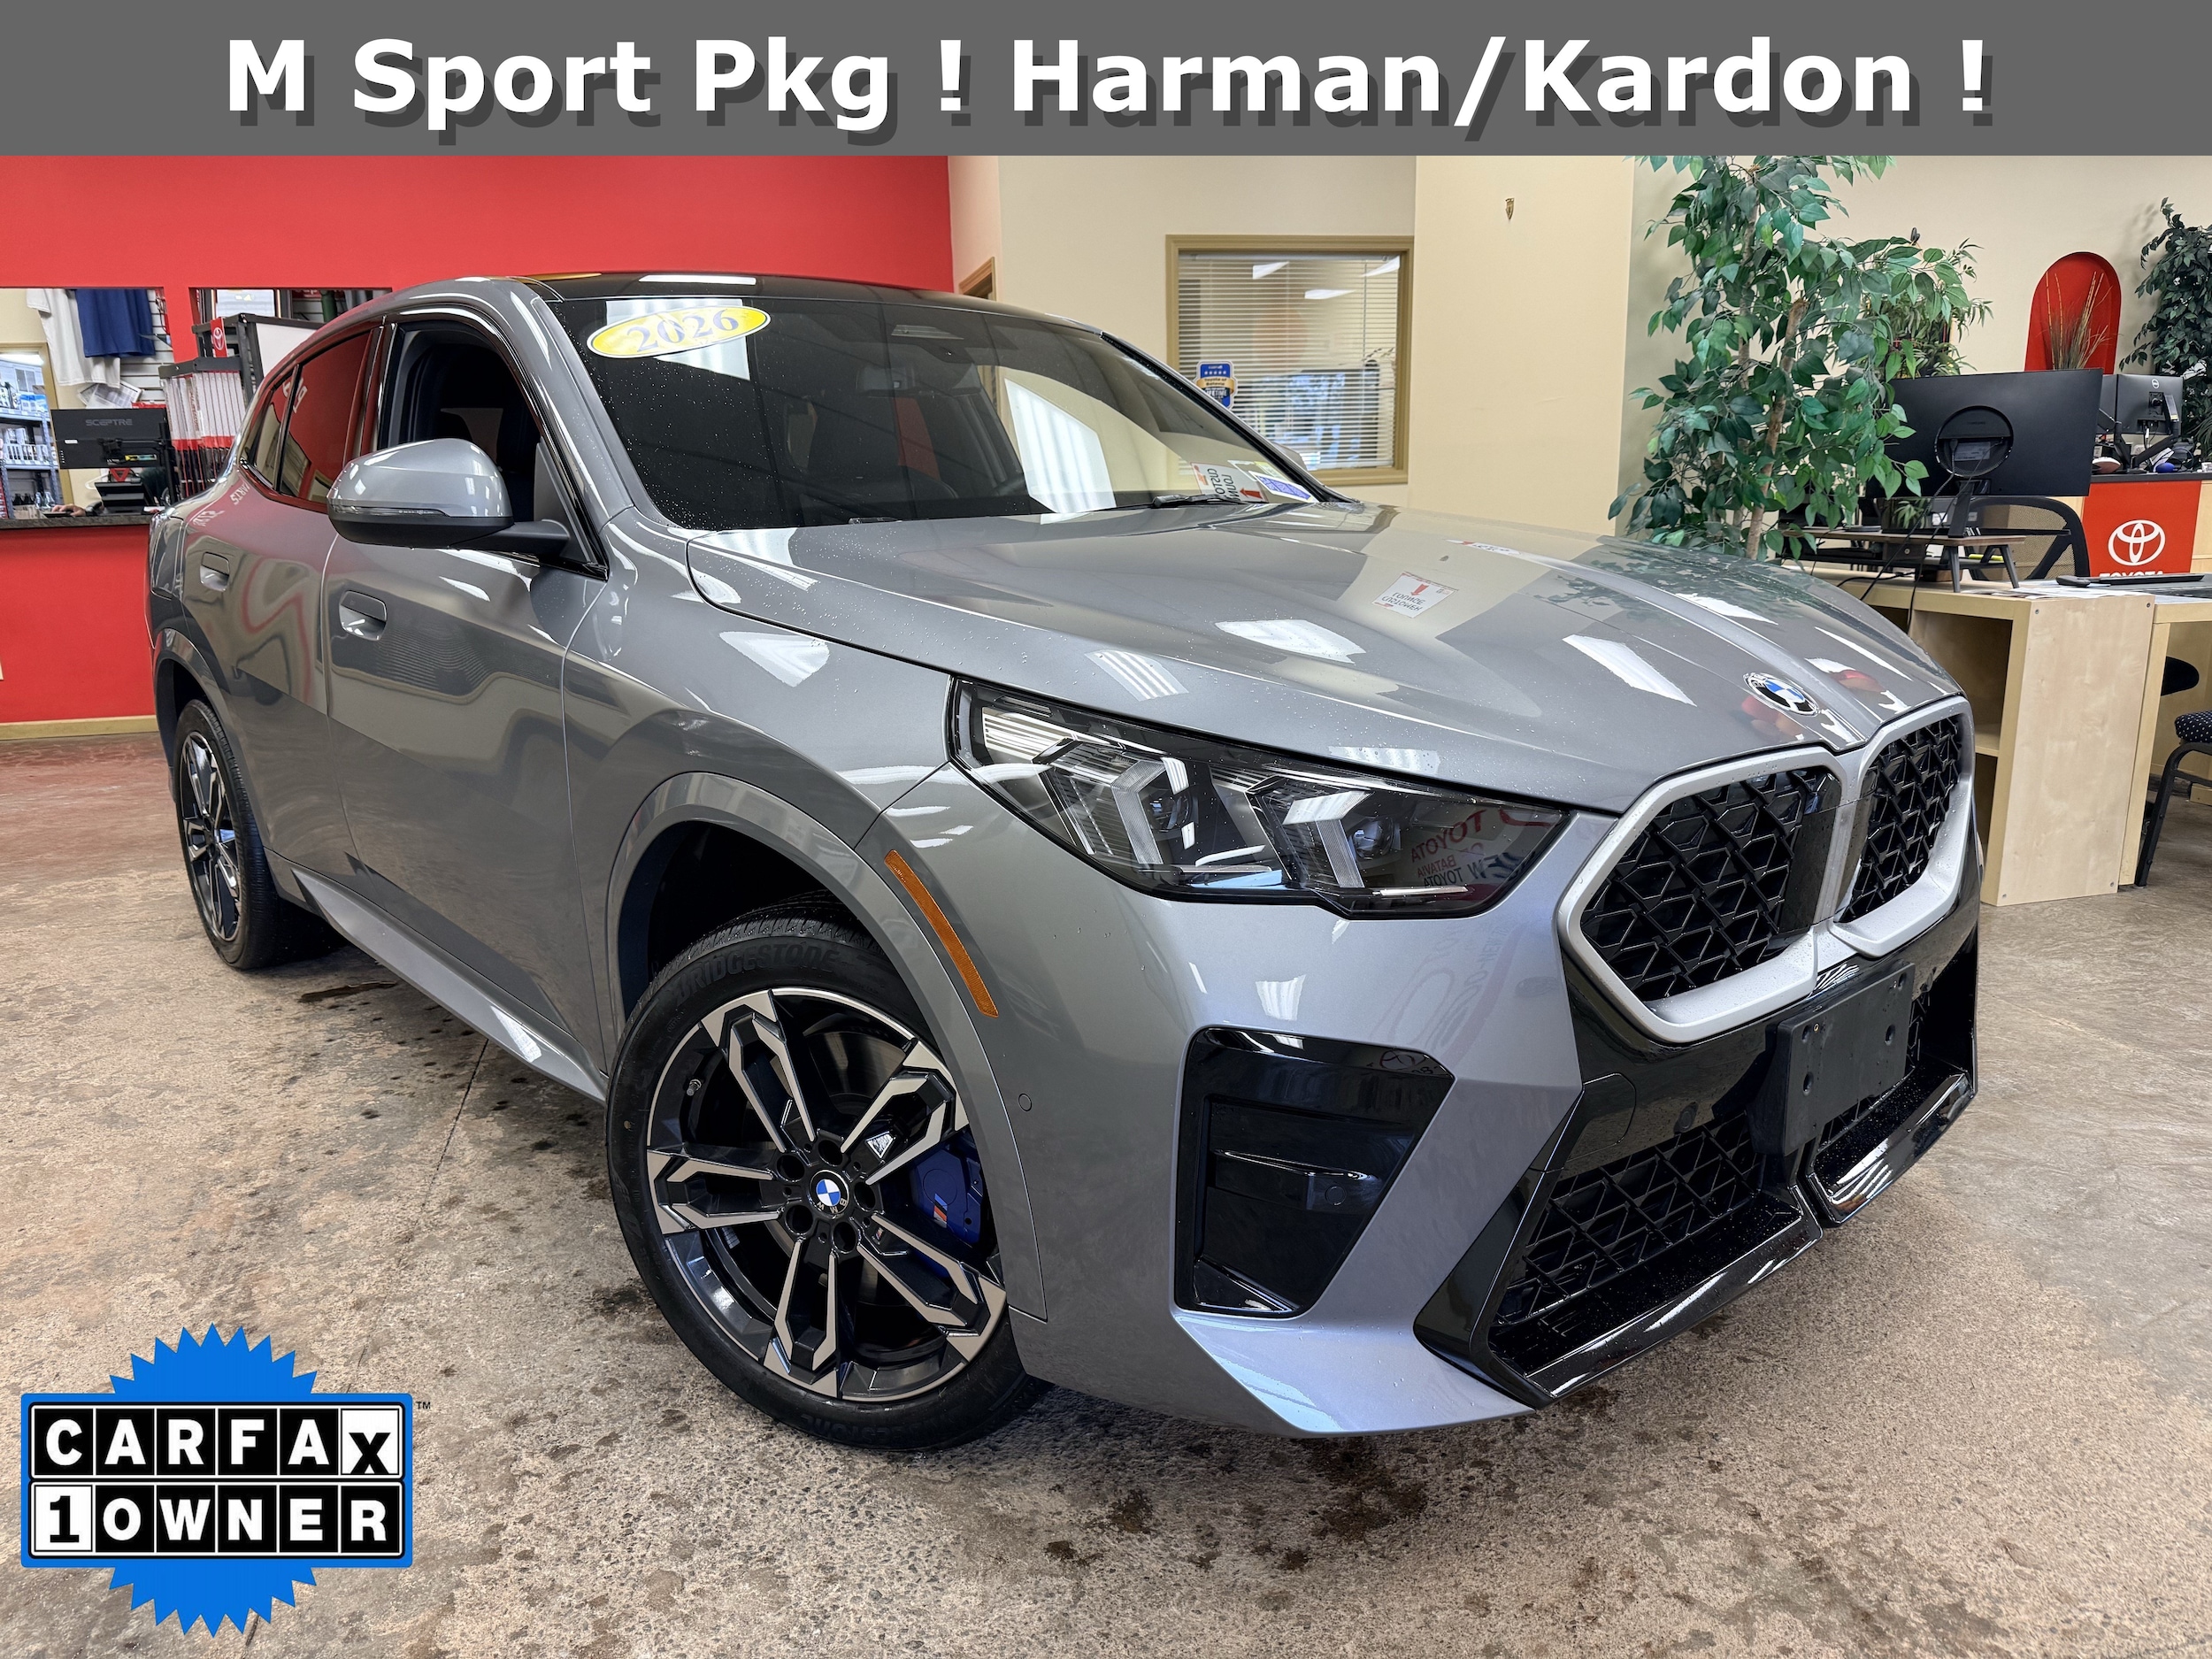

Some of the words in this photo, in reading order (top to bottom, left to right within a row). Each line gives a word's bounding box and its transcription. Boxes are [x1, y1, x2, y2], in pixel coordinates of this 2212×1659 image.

[626, 309, 739, 353] 2026
[672, 941, 839, 1004] BRIDGESTONE
[816, 1197, 848, 1214] BMW
